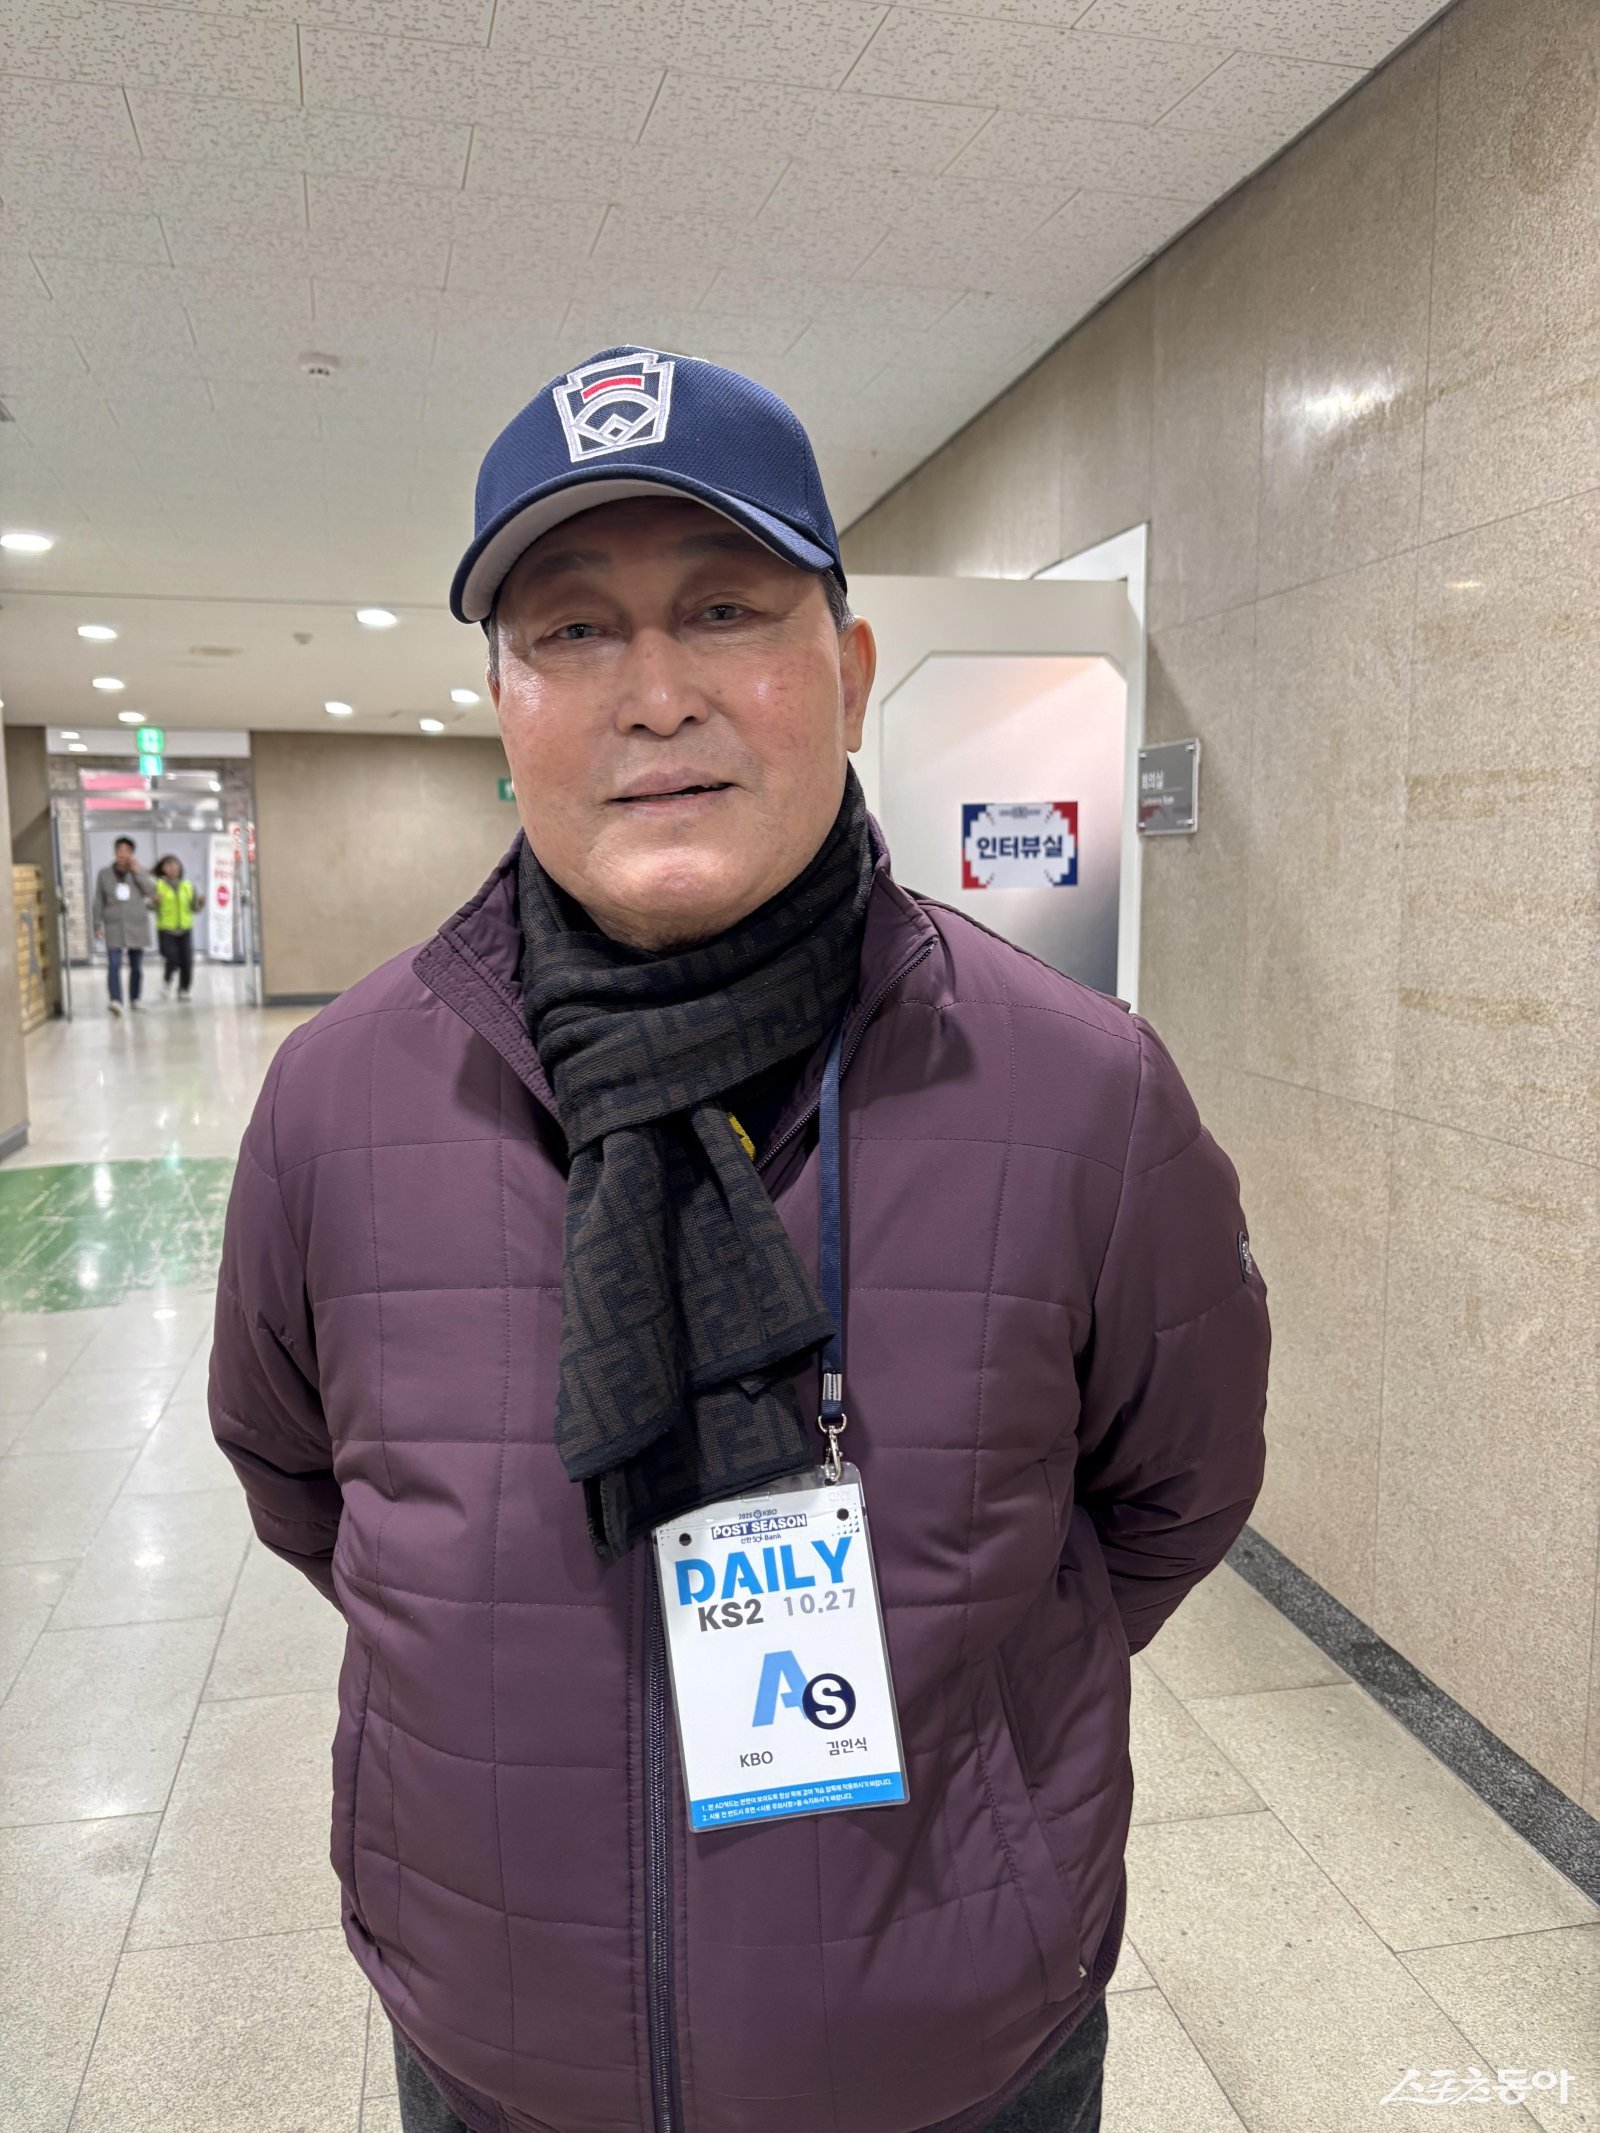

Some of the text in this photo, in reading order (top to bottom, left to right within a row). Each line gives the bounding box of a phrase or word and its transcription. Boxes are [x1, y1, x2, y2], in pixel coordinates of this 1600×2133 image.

[976, 834, 1064, 859] 인터뷰실
[762, 1508, 777, 1516] KBO
[712, 1515, 807, 1539] POST SEASON
[675, 1536, 852, 1606] DAILY
[698, 1588, 856, 1632] KS2 10.27
[752, 1650, 848, 1728] A S
[826, 1737, 868, 1756] 김인식
[739, 1751, 773, 1768] KBO
